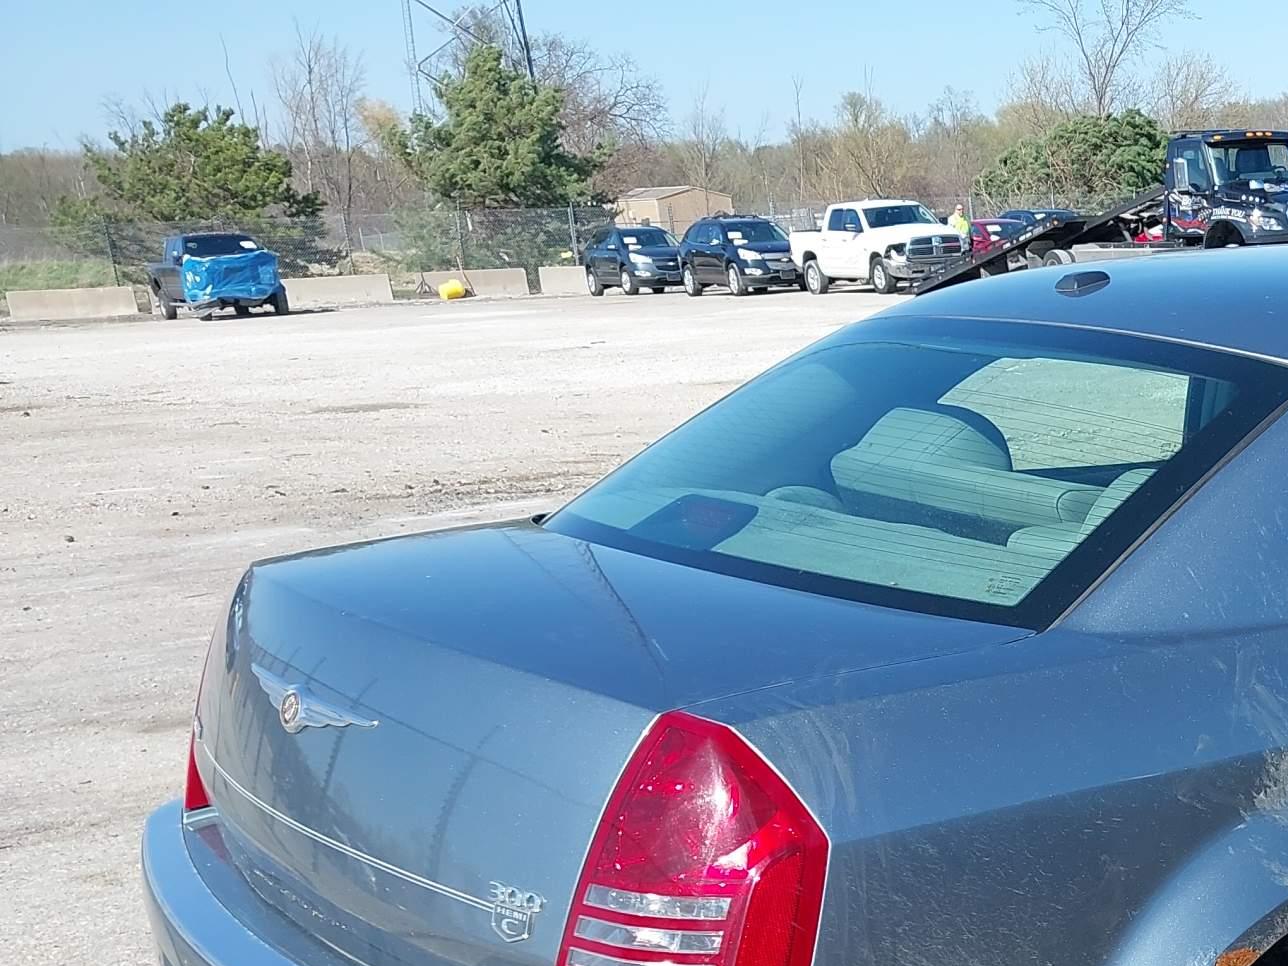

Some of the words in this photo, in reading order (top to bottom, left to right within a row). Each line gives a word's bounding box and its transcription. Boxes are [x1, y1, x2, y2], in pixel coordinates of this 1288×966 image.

[488, 880, 543, 912] 300
[496, 905, 528, 922] HEMI
[501, 917, 519, 936] C
